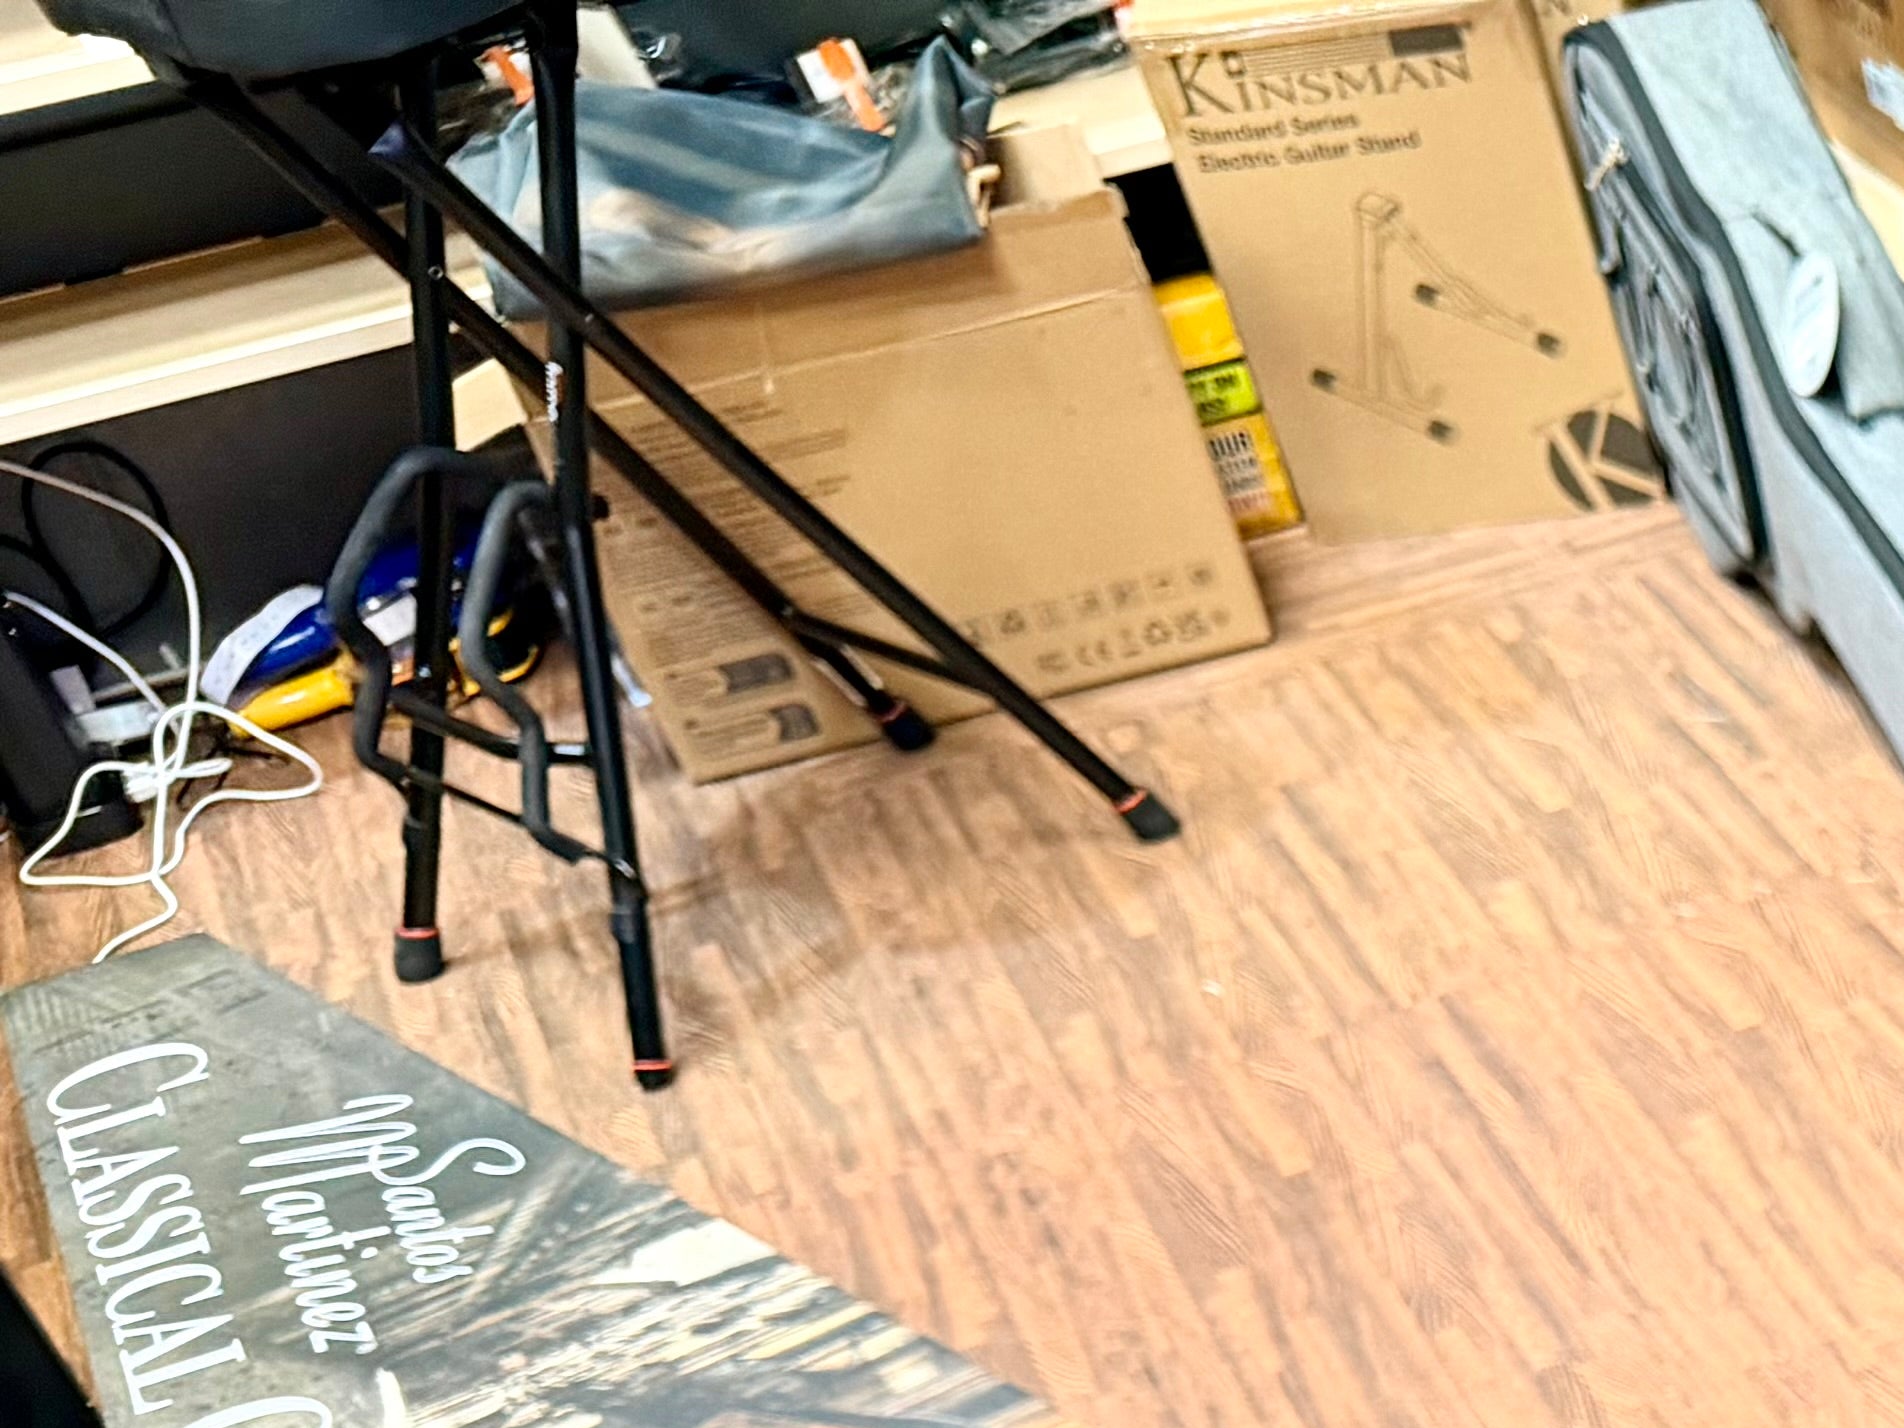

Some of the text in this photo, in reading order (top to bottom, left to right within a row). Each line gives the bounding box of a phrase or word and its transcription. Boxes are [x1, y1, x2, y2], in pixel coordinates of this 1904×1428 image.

[1187, 112, 1360, 146] Standard Series
[1197, 128, 1422, 174] Electric Guitar Stand
[45, 1041, 248, 1416] CLASSICAL
[237, 1093, 421, 1355] Martinez
[366, 1137, 527, 1285] Santos
